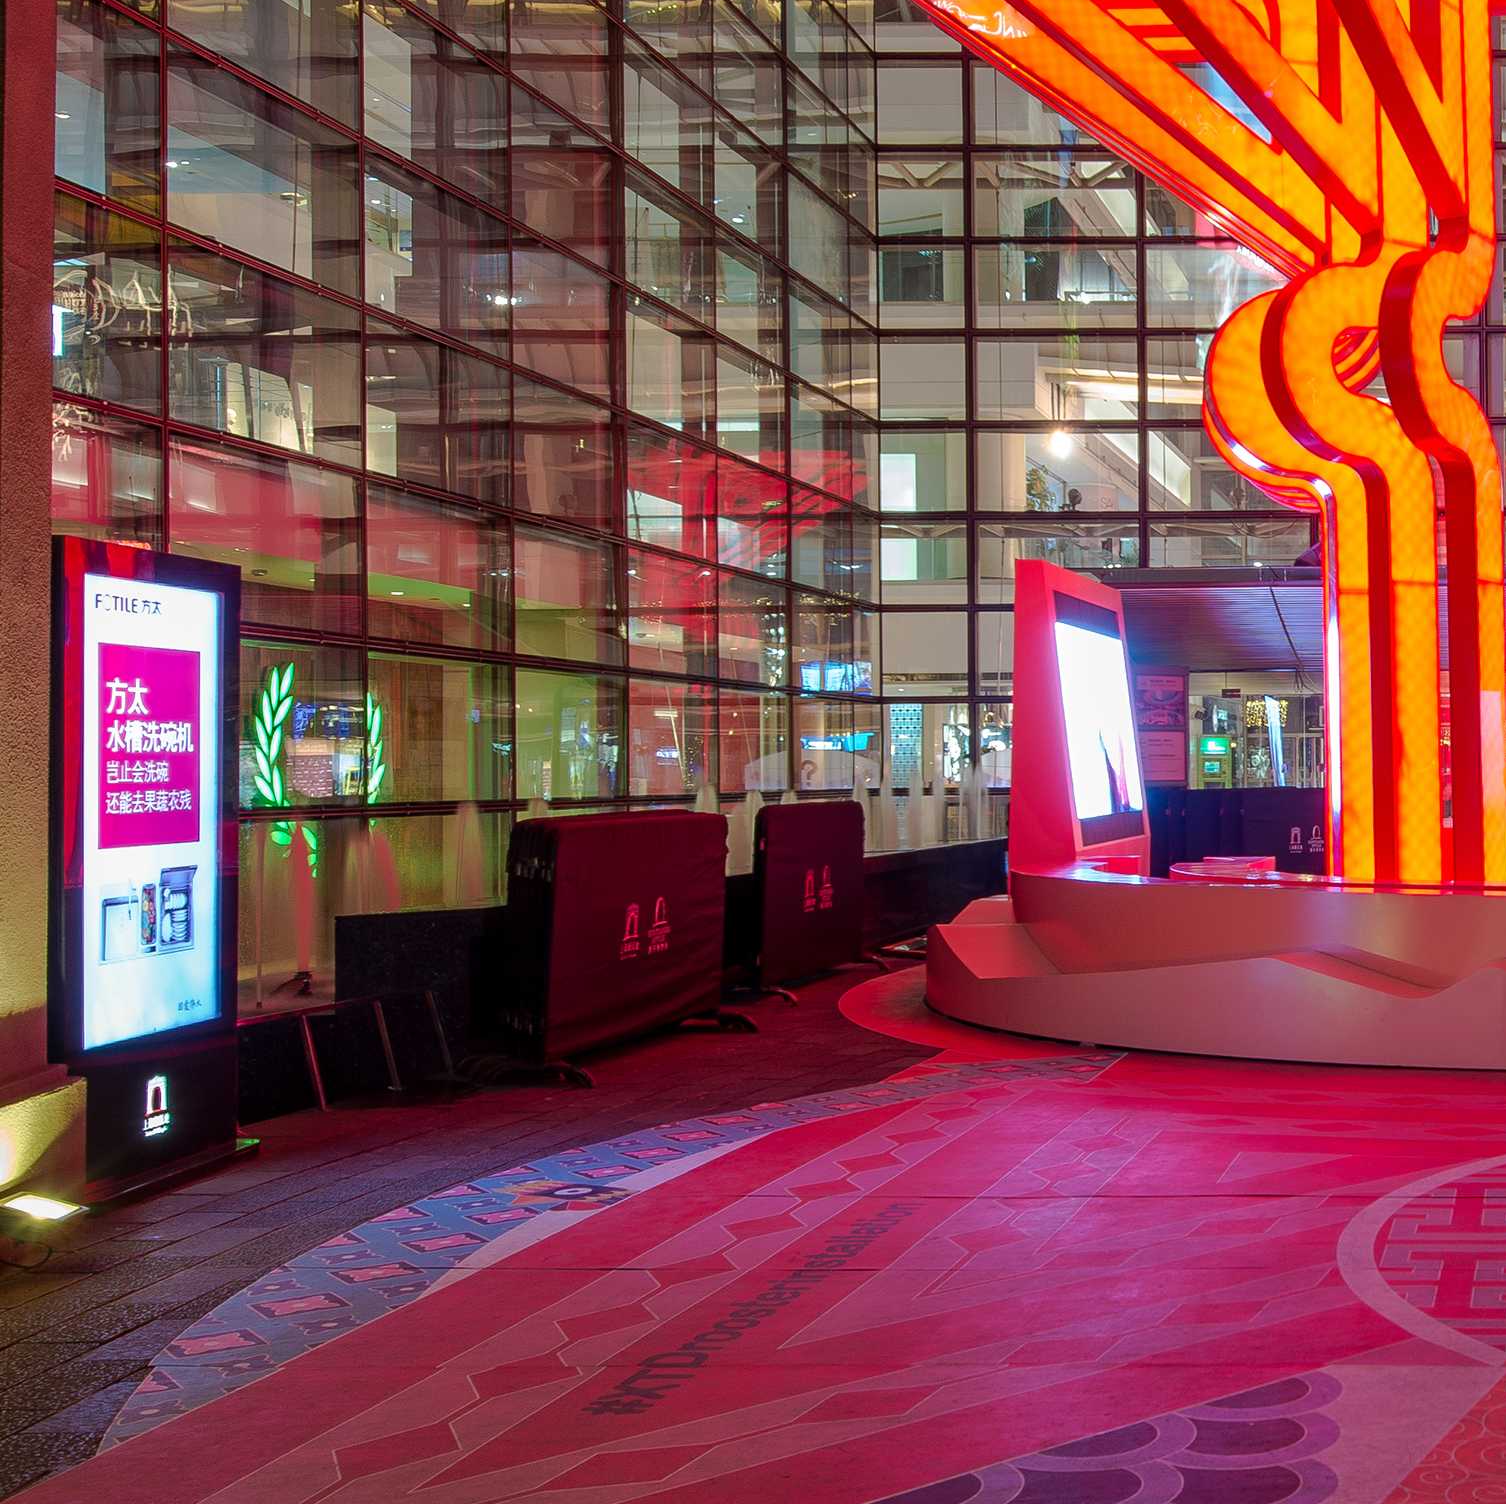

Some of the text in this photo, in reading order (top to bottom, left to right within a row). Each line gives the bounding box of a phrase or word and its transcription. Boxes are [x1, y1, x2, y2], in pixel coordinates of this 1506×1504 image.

[95, 593, 139, 614] FOTILE
[105, 677, 150, 715] 方太
[106, 719, 195, 753] 水槽洗碗机
[106, 760, 170, 784] 岂止会洗碗
[105, 789, 192, 814] 还能去果蔬农残
